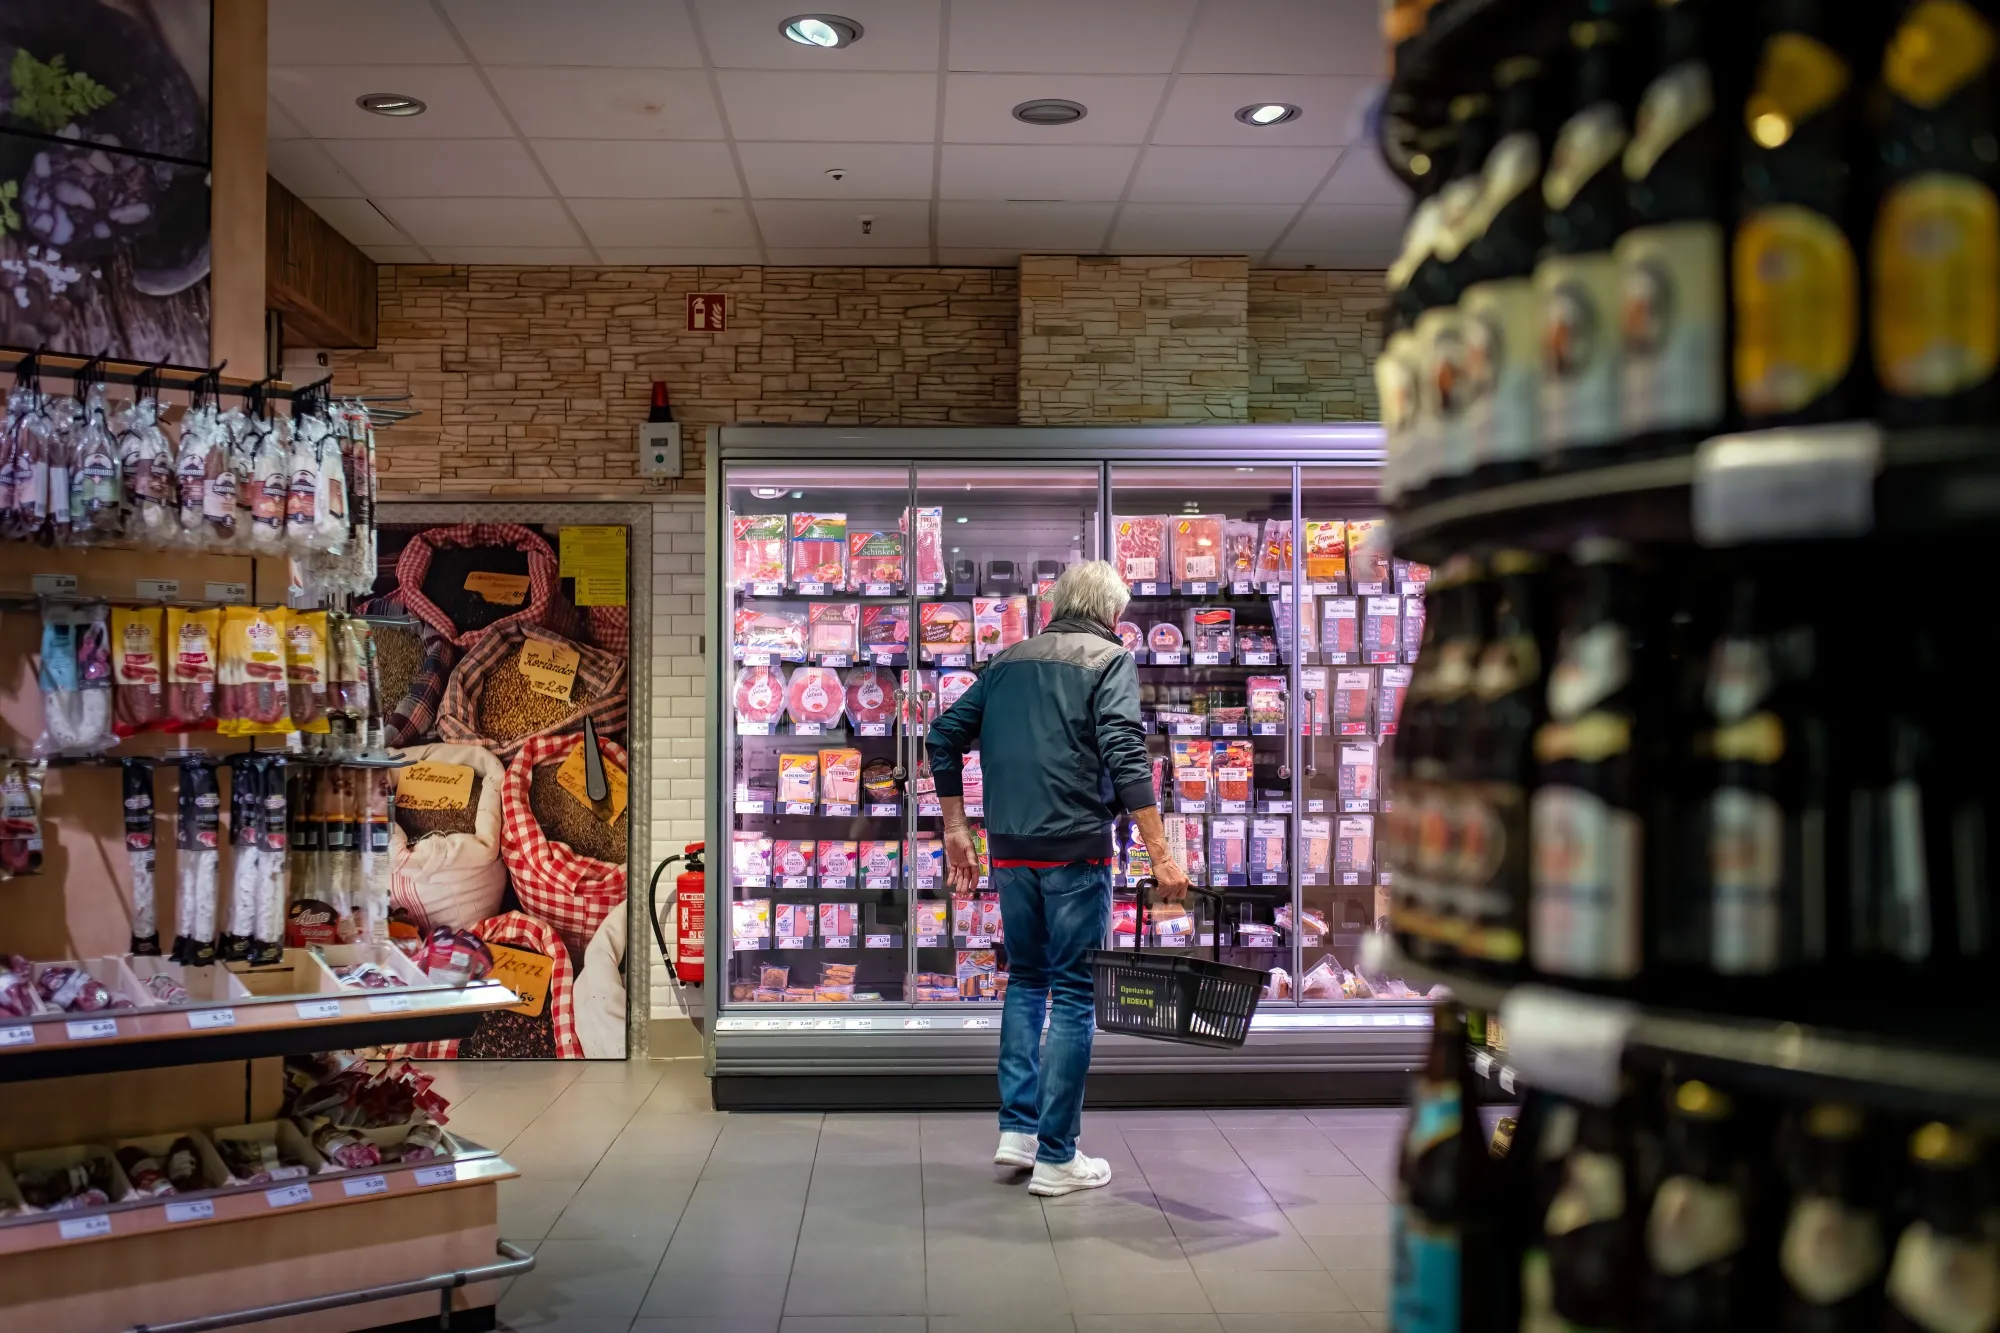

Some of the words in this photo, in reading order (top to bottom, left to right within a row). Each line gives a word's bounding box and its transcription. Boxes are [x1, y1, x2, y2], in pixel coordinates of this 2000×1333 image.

[1314, 534, 1335, 544] Tapas
[862, 547, 895, 556] Schinken
[523, 652, 576, 676] Koriander
[405, 766, 464, 785] Kümmel
[1120, 985, 1145, 995] Eigentum
[1144, 988, 1154, 996] der
[1126, 997, 1148, 1006] EDEKA
